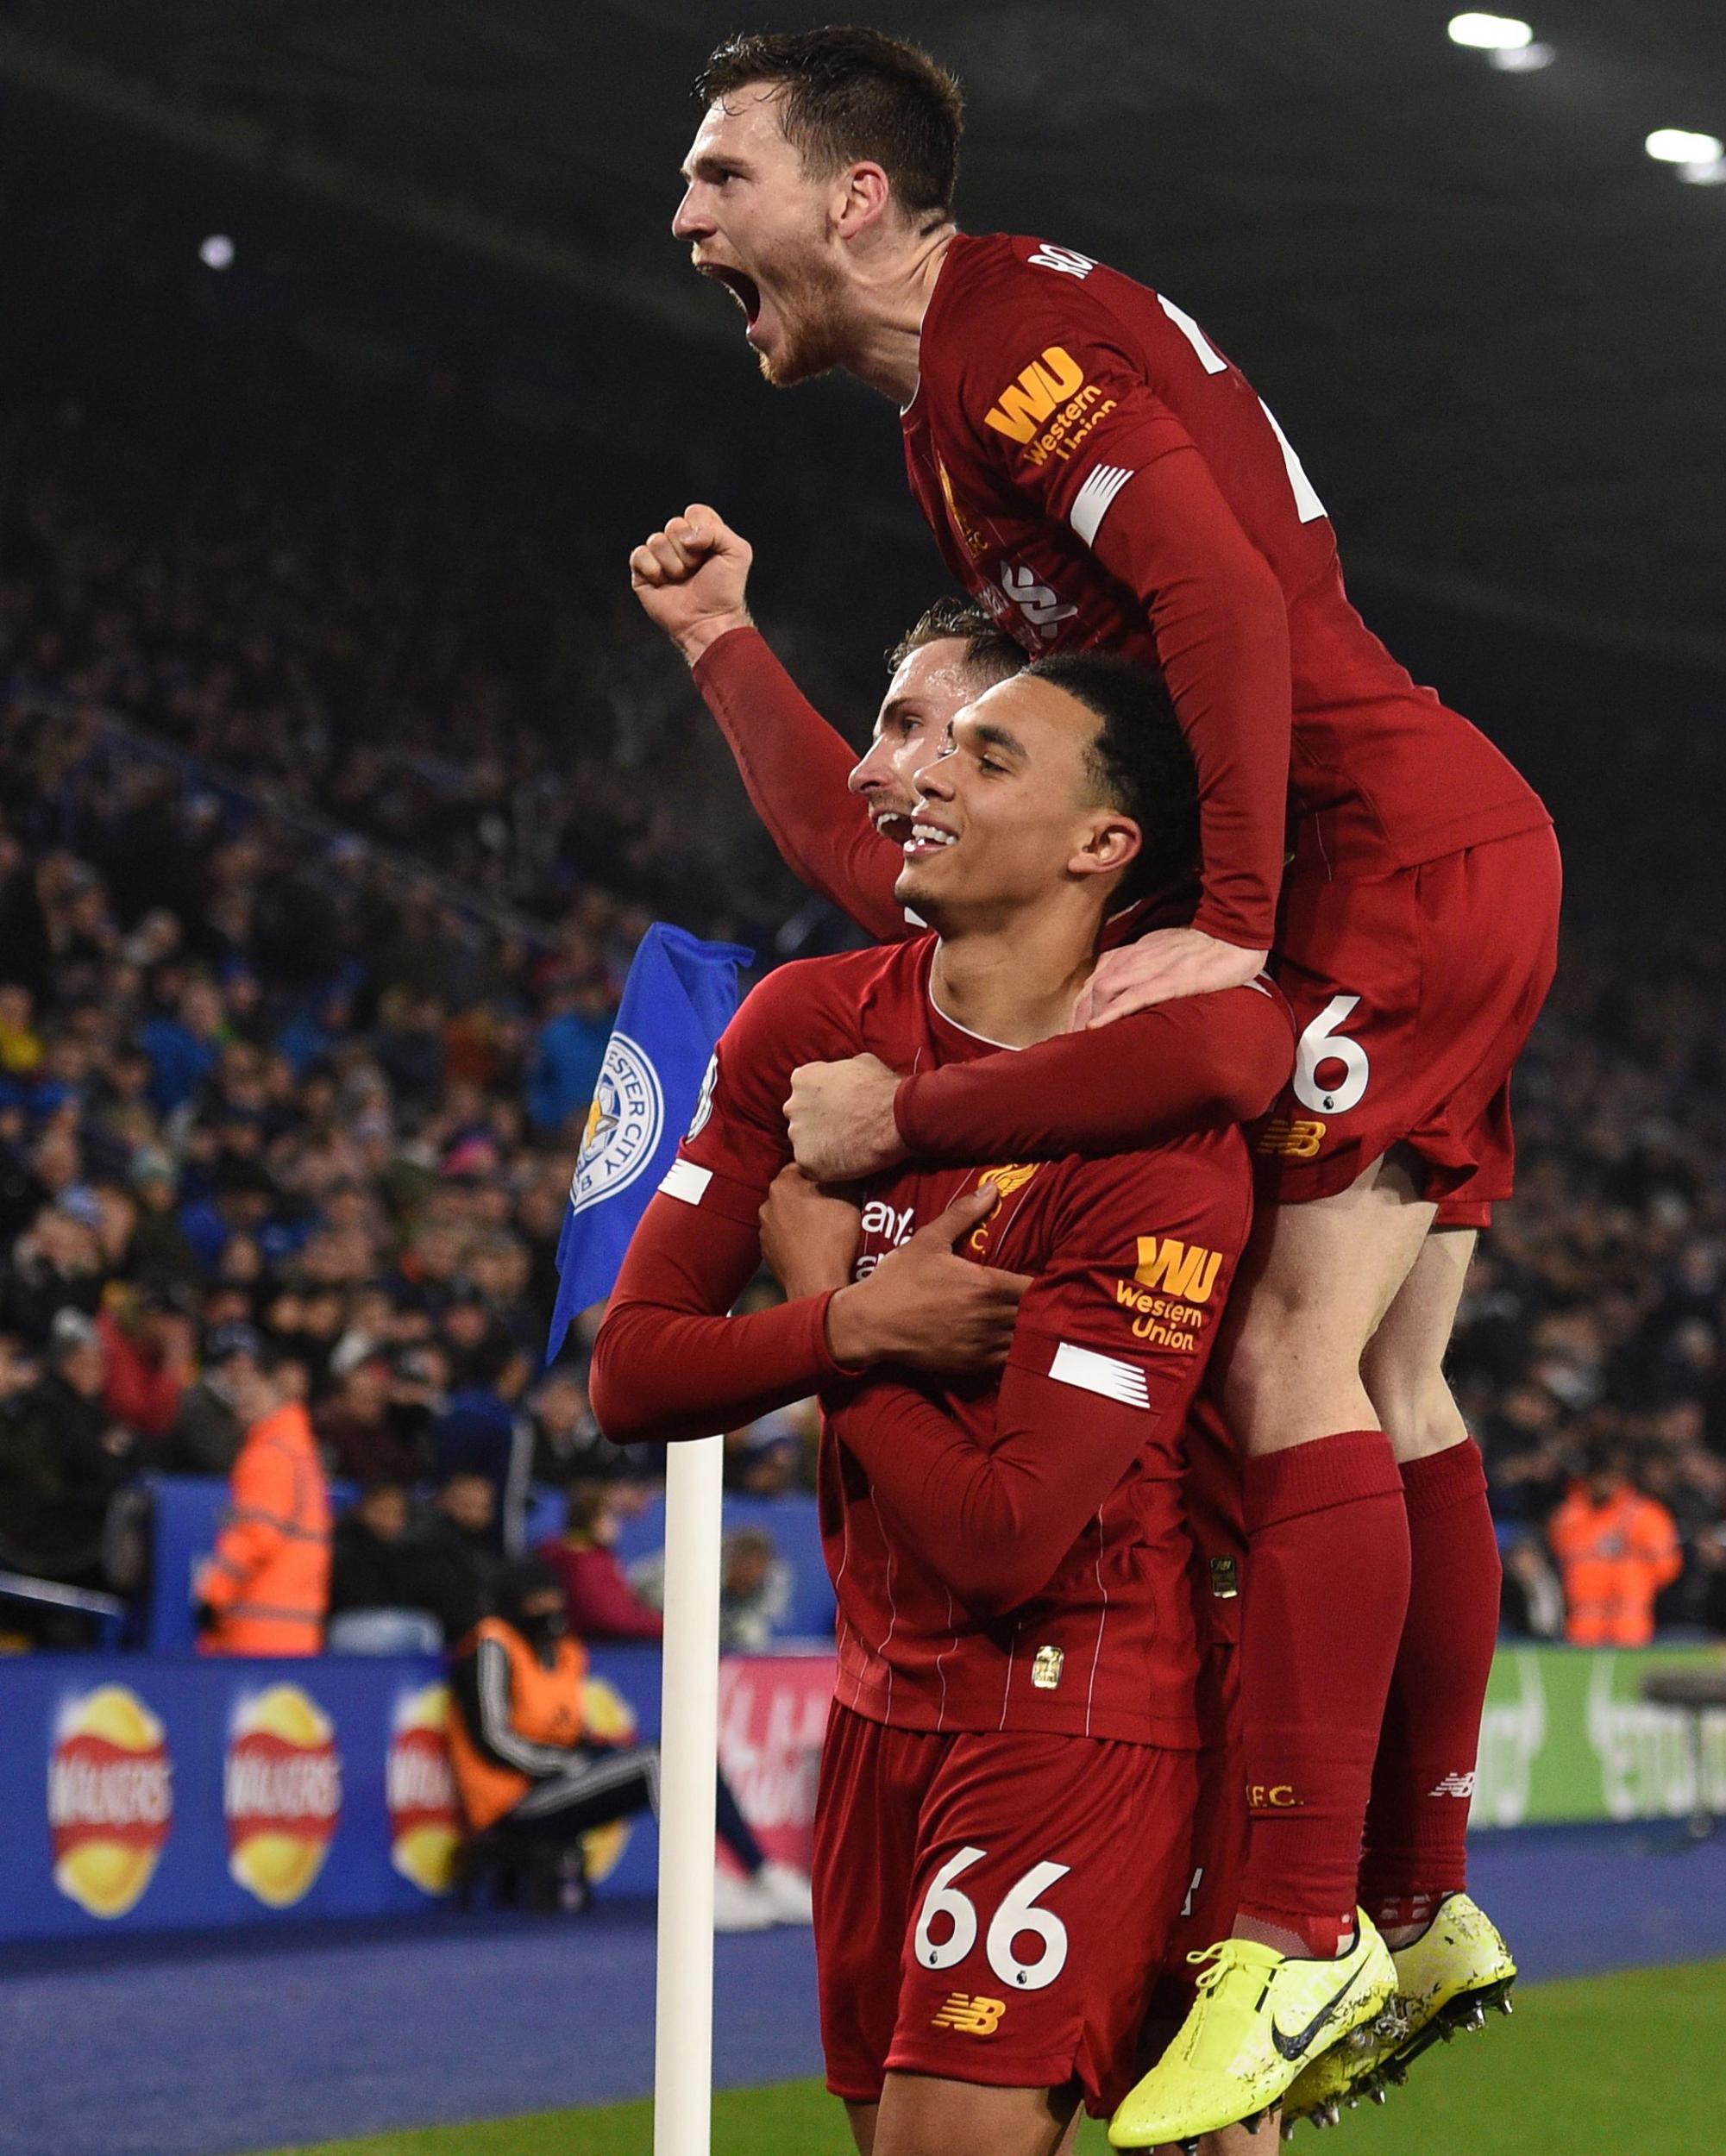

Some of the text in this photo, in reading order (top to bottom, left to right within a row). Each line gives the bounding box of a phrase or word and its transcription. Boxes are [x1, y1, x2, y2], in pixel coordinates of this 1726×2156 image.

[984, 346, 1083, 445] WU
[1023, 385, 1102, 467] Western
[1293, 995, 1370, 1114] 6
[604, 1123, 642, 1176] CITY
[1116, 1279, 1202, 1328] Western
[1133, 1236, 1223, 1303] WU
[1132, 1315, 1194, 1351] Union
[914, 1846, 1072, 1991] 66
